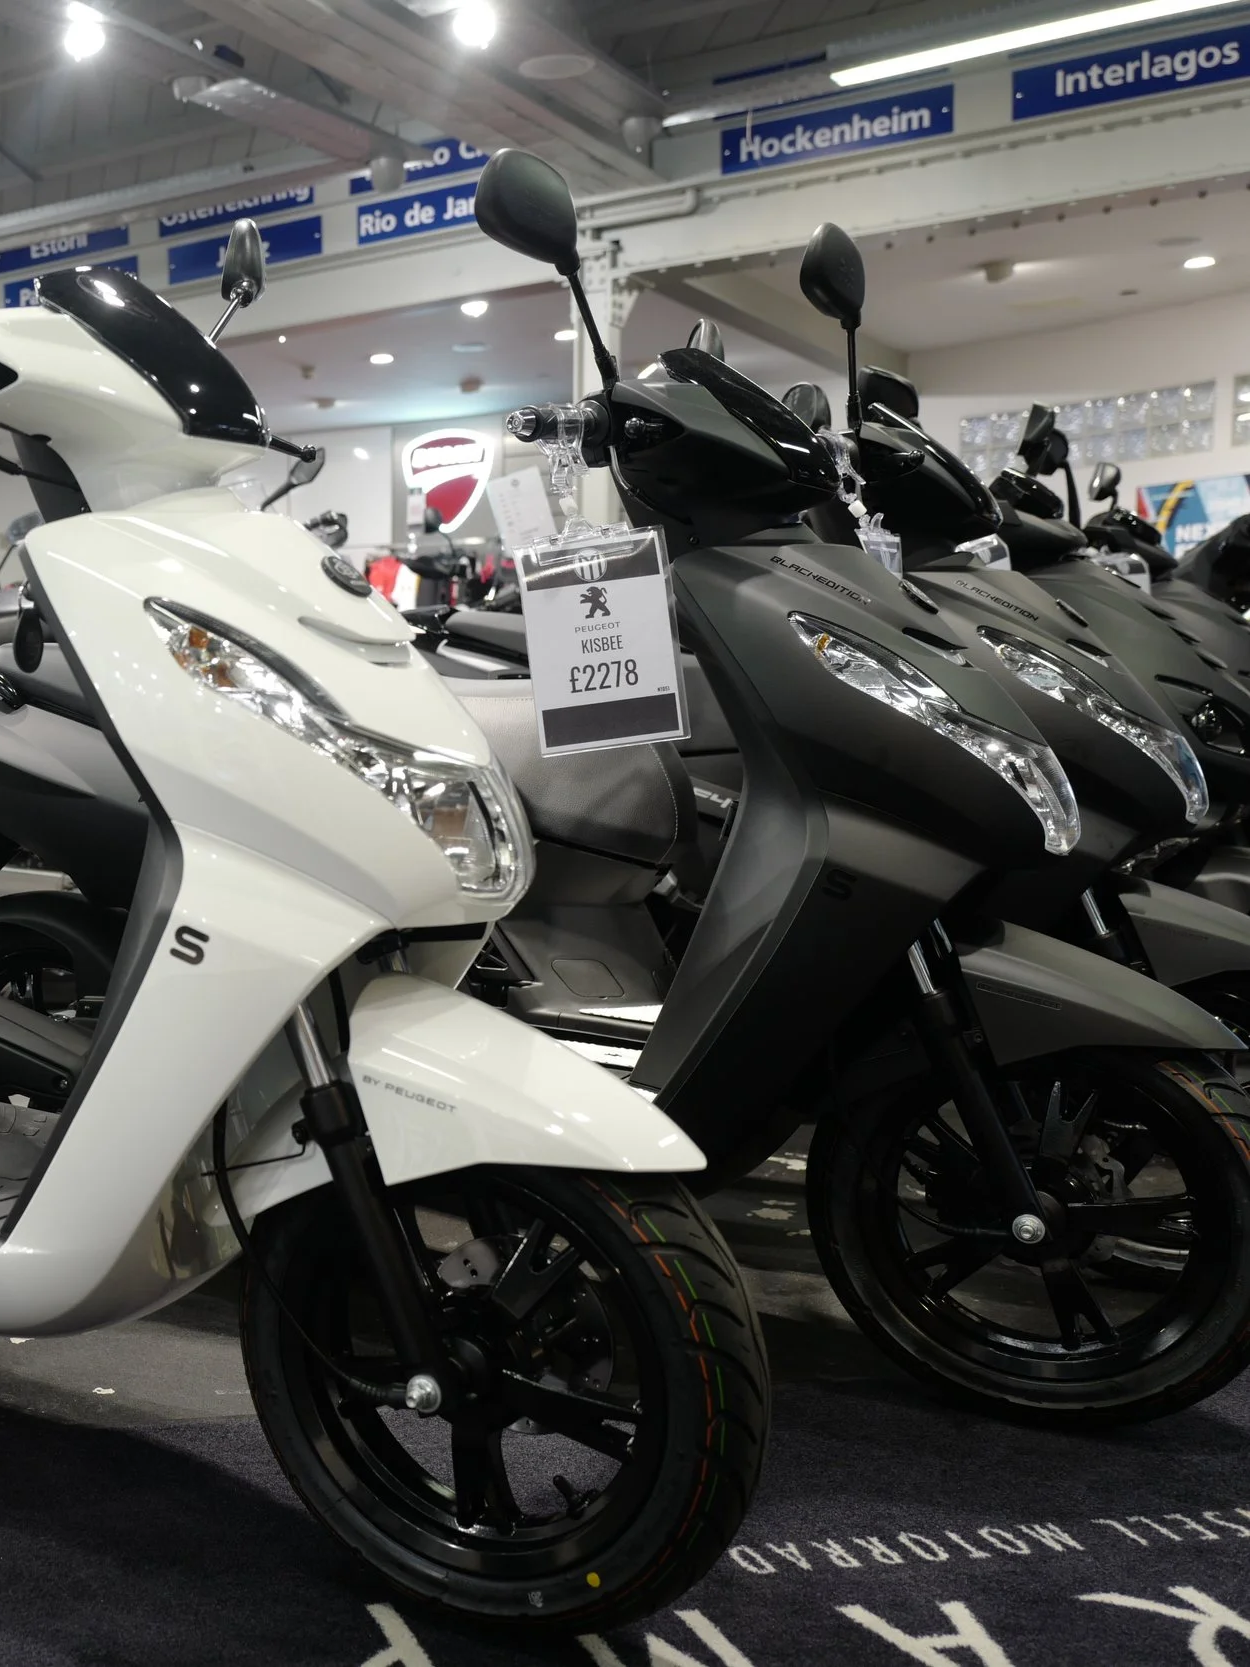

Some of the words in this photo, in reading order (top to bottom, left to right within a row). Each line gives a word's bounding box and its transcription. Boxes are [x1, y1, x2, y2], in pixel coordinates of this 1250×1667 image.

[1055, 41, 1240, 97] Interlagos
[739, 105, 931, 163] Hockenheim
[359, 209, 398, 237] Rio
[404, 201, 436, 228] de
[574, 621, 621, 633] PEUGEOT
[581, 634, 624, 654] KISBEE
[569, 658, 639, 694] £2278
[170, 925, 210, 965] S
[361, 1074, 380, 1087] BY
[384, 1082, 458, 1113] PEUGEOT
[728, 1523, 1086, 1574] MOTORRAD
